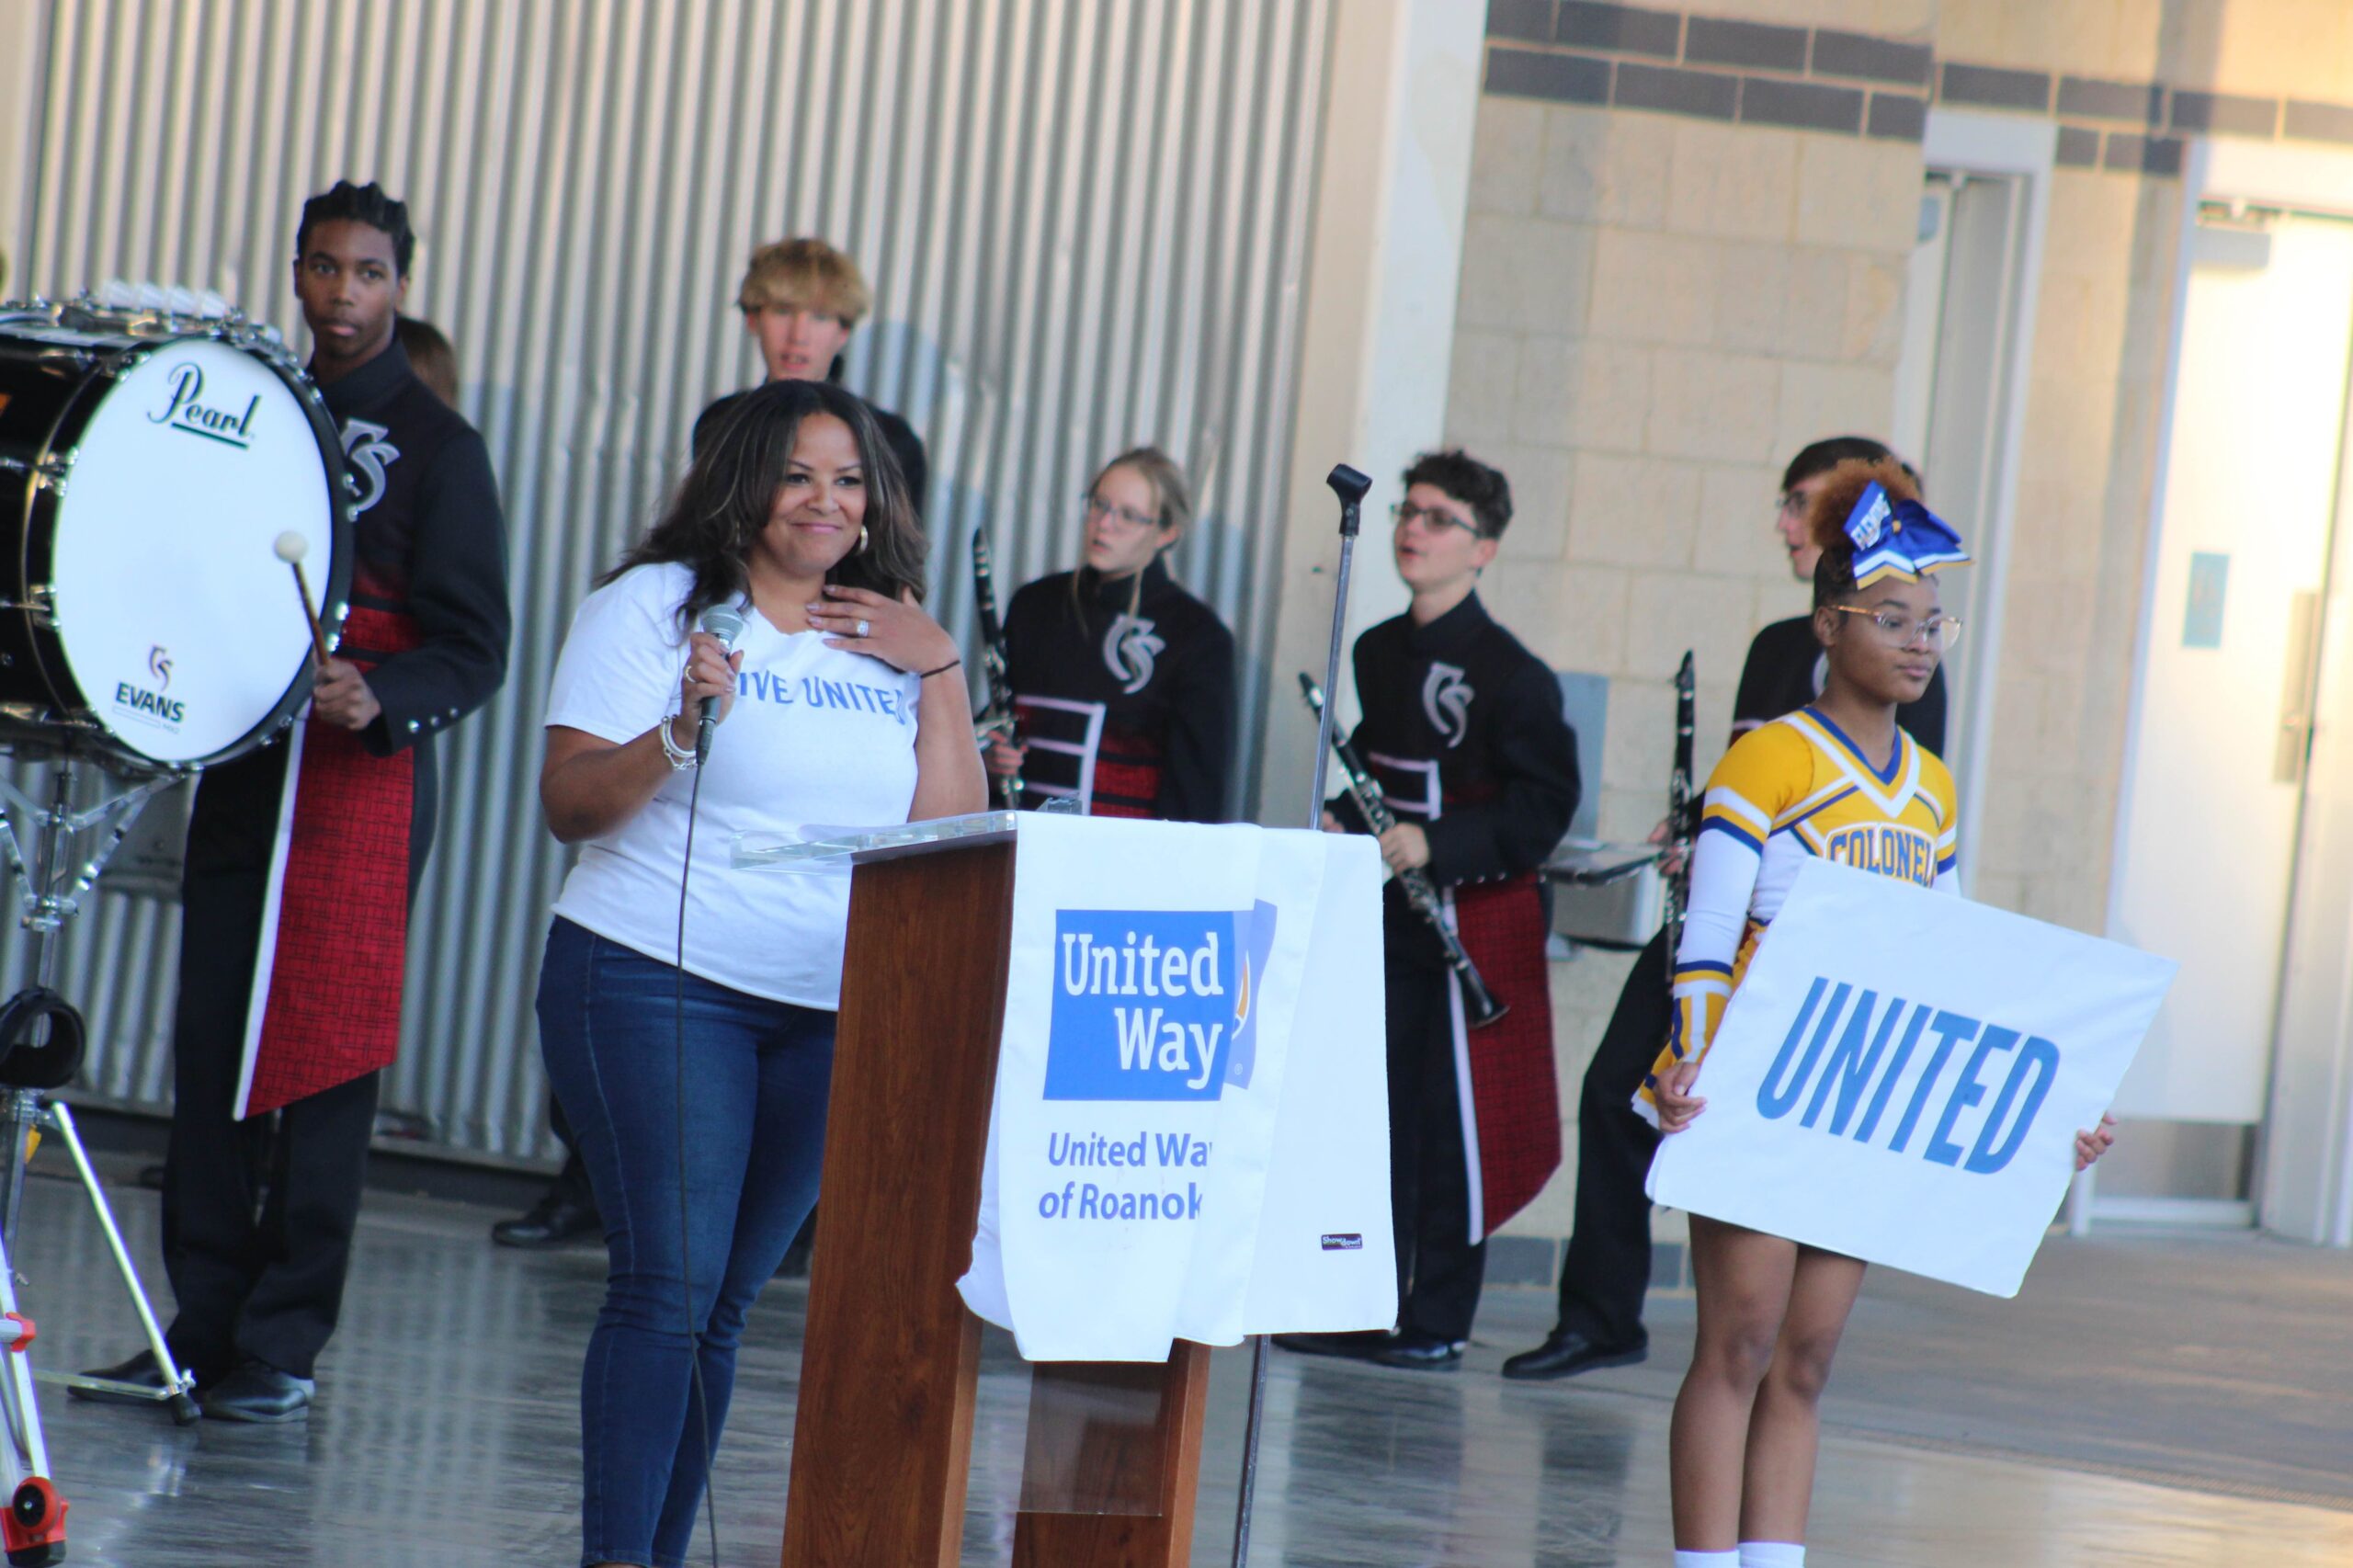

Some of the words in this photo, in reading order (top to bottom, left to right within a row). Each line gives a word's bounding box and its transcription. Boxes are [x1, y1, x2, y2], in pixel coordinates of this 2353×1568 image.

[147, 362, 261, 437] Pearl
[116, 681, 186, 723] EVANS
[739, 670, 793, 705] IVE
[1829, 827, 1935, 889] COLONEL
[1062, 930, 1225, 997] United
[1113, 1006, 1224, 1091] Way
[1756, 975, 2061, 1176] UNITED
[1048, 1131, 1148, 1167] United
[1154, 1132, 1213, 1167] Wa
[1039, 1180, 1075, 1220] of
[1078, 1181, 1203, 1221] Roanok
